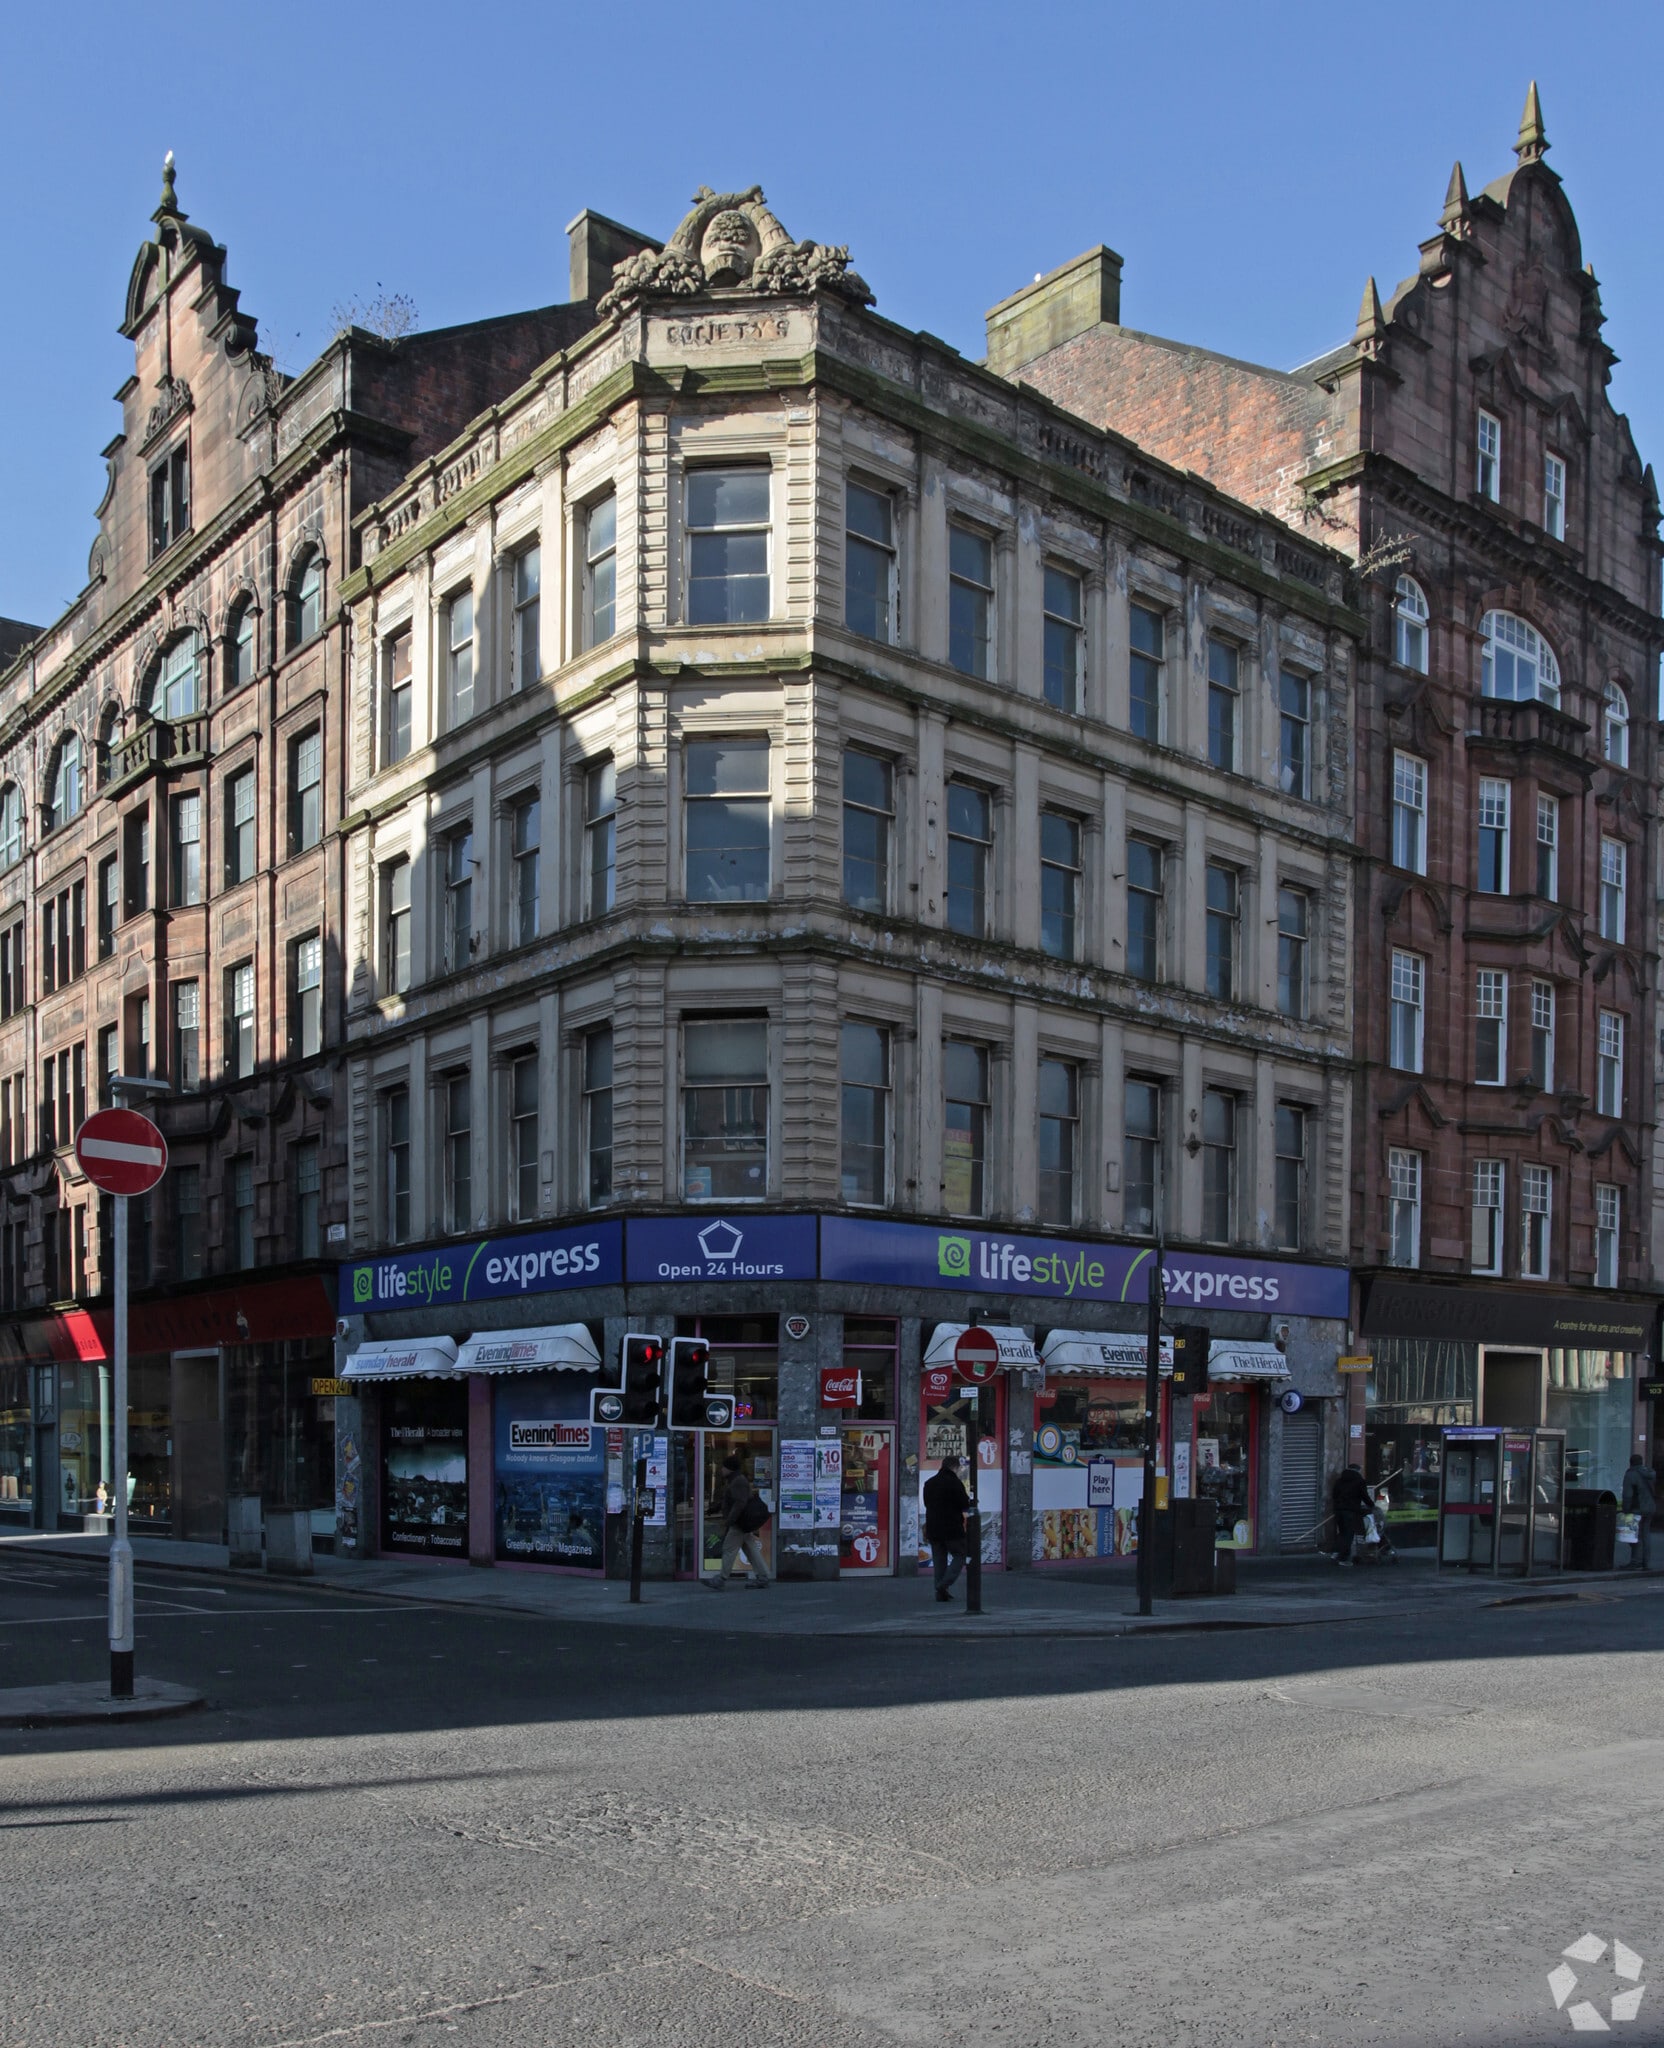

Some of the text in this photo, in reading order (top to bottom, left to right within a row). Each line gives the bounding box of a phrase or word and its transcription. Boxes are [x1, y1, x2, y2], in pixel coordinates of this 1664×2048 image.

[486, 1243, 600, 1288] express
[658, 1262, 784, 1279] Open 24 Hours
[980, 1241, 1105, 1296] lifestyle
[378, 1258, 453, 1303] lifestyle
[1231, 1356, 1287, 1370] The Herald
[313, 1379, 335, 1393] OPEN
[511, 1424, 590, 1444] EveningTimes
[642, 1433, 651, 1451] P
[505, 1454, 598, 1465] Nobody knows Glasgow better!
[1093, 1475, 1110, 1485] Play
[1092, 1485, 1110, 1494] here
[506, 1538, 593, 1556] Greetings Cards Magazines
